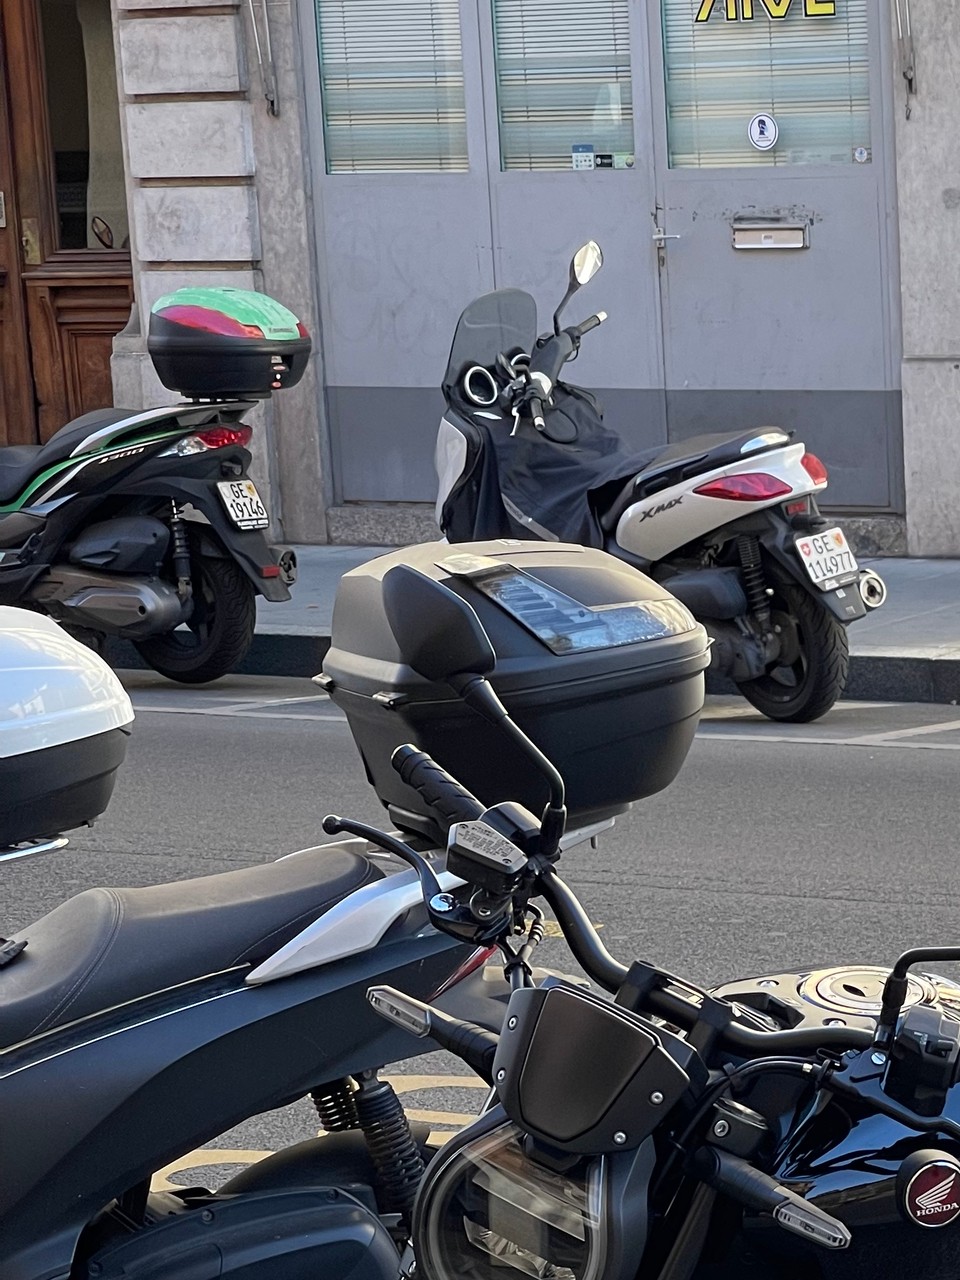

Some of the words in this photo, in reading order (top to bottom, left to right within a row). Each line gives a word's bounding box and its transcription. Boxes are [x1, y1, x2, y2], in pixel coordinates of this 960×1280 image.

[229, 482, 248, 499] GE
[230, 500, 265, 519] 19146
[812, 534, 834, 554] GE
[808, 551, 853, 579] 114977
[916, 1202, 960, 1217] HONDA
